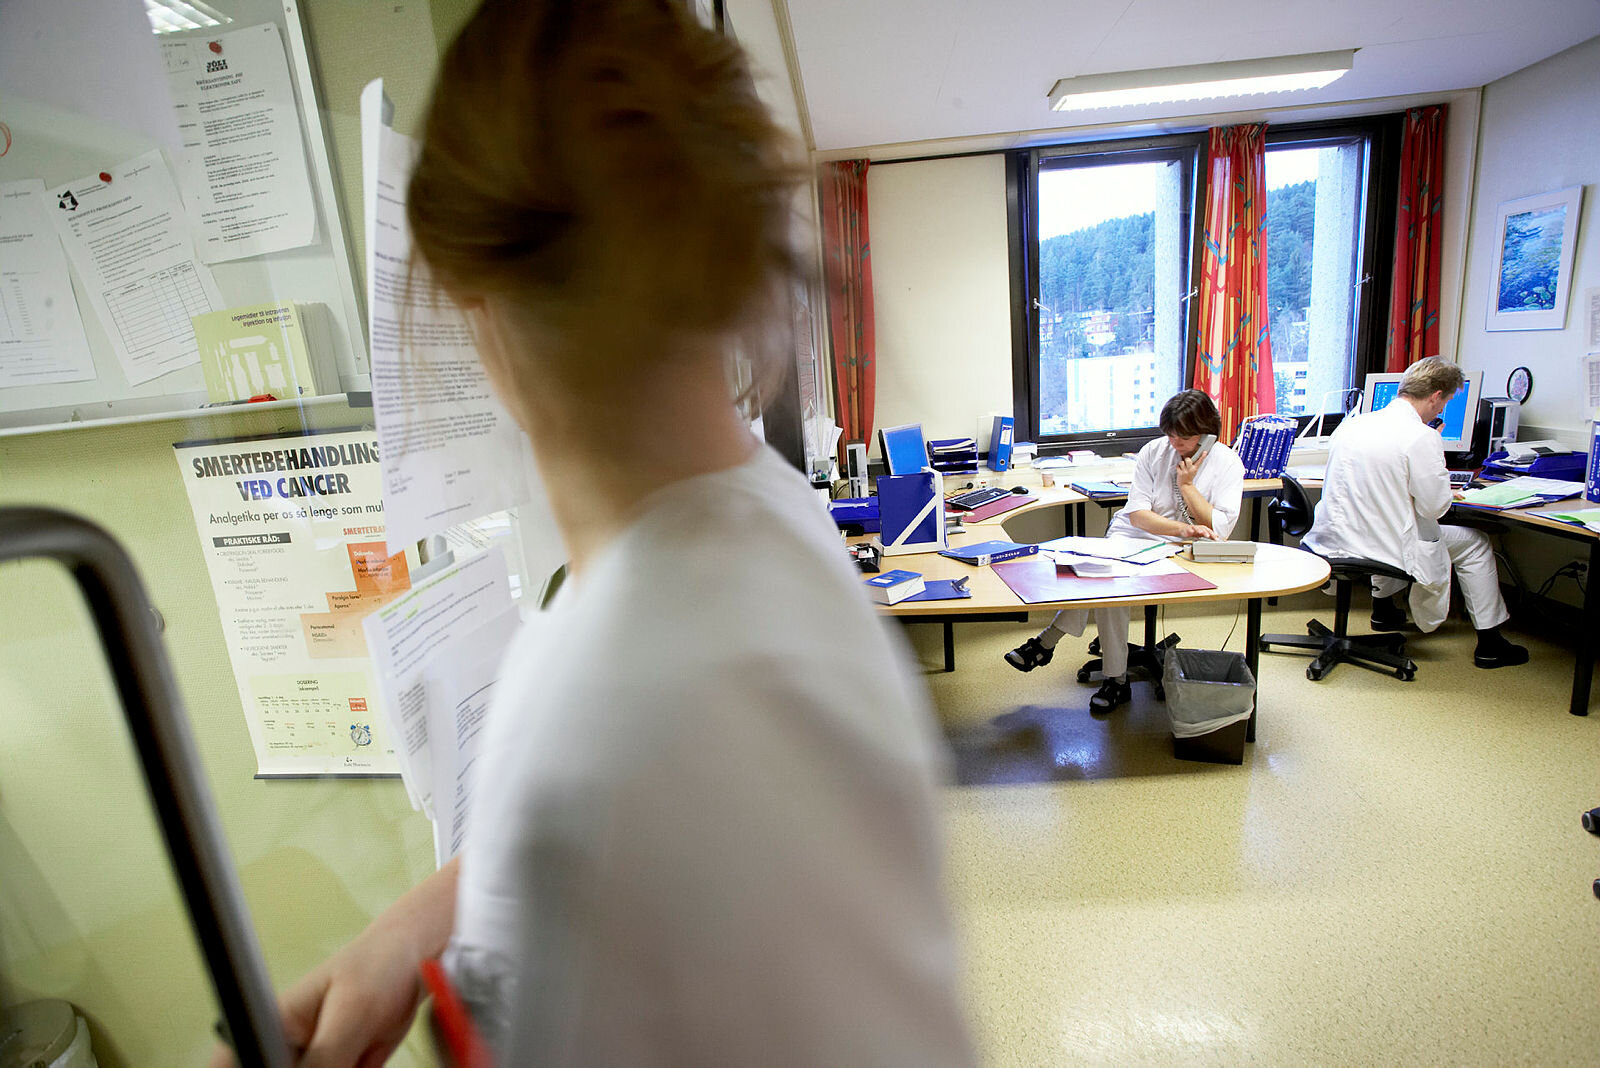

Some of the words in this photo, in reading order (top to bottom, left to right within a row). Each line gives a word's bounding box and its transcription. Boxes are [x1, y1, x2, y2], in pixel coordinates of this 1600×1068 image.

[235, 479, 273, 502] VED
[276, 473, 352, 499] CANCER
[209, 510, 261, 526] Analgetika
[263, 512, 279, 523] per
[282, 510, 293, 519] os
[296, 507, 307, 518] så
[309, 505, 338, 519] lenge
[341, 505, 362, 515] som
[223, 536, 262, 546] PRAKTISKE
